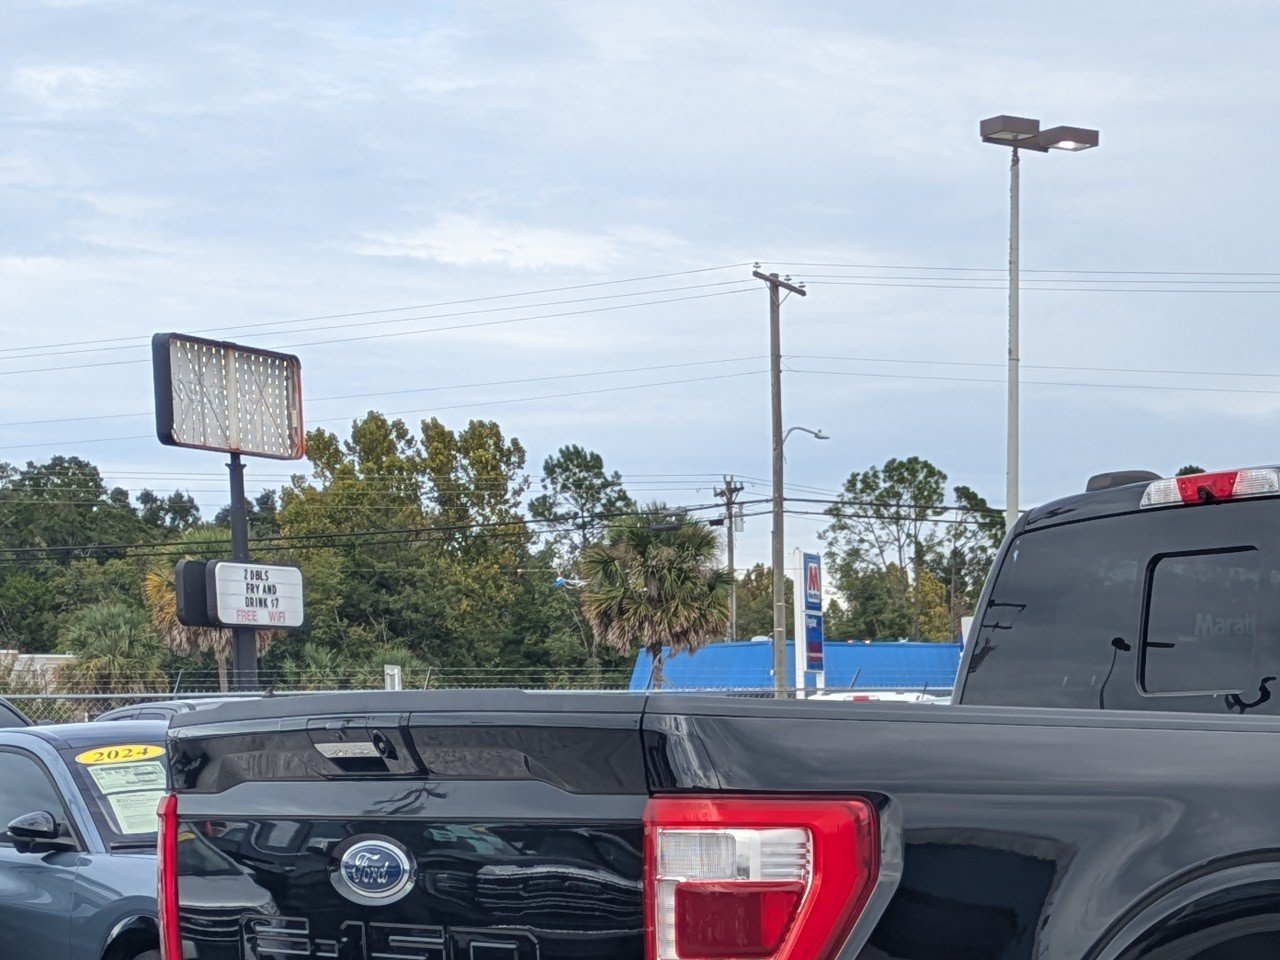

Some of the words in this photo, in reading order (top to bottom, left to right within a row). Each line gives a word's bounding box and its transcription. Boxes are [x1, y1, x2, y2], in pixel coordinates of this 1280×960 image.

[244, 569, 248, 581] 2
[250, 570, 269, 581] DBLS
[246, 583, 260, 595] FRY
[262, 584, 277, 595] AND
[245, 597, 268, 608] DRINK
[271, 598, 279, 609] $7
[236, 610, 257, 622] FREE
[93, 746, 149, 763] 2024
[352, 851, 390, 884] Ford
